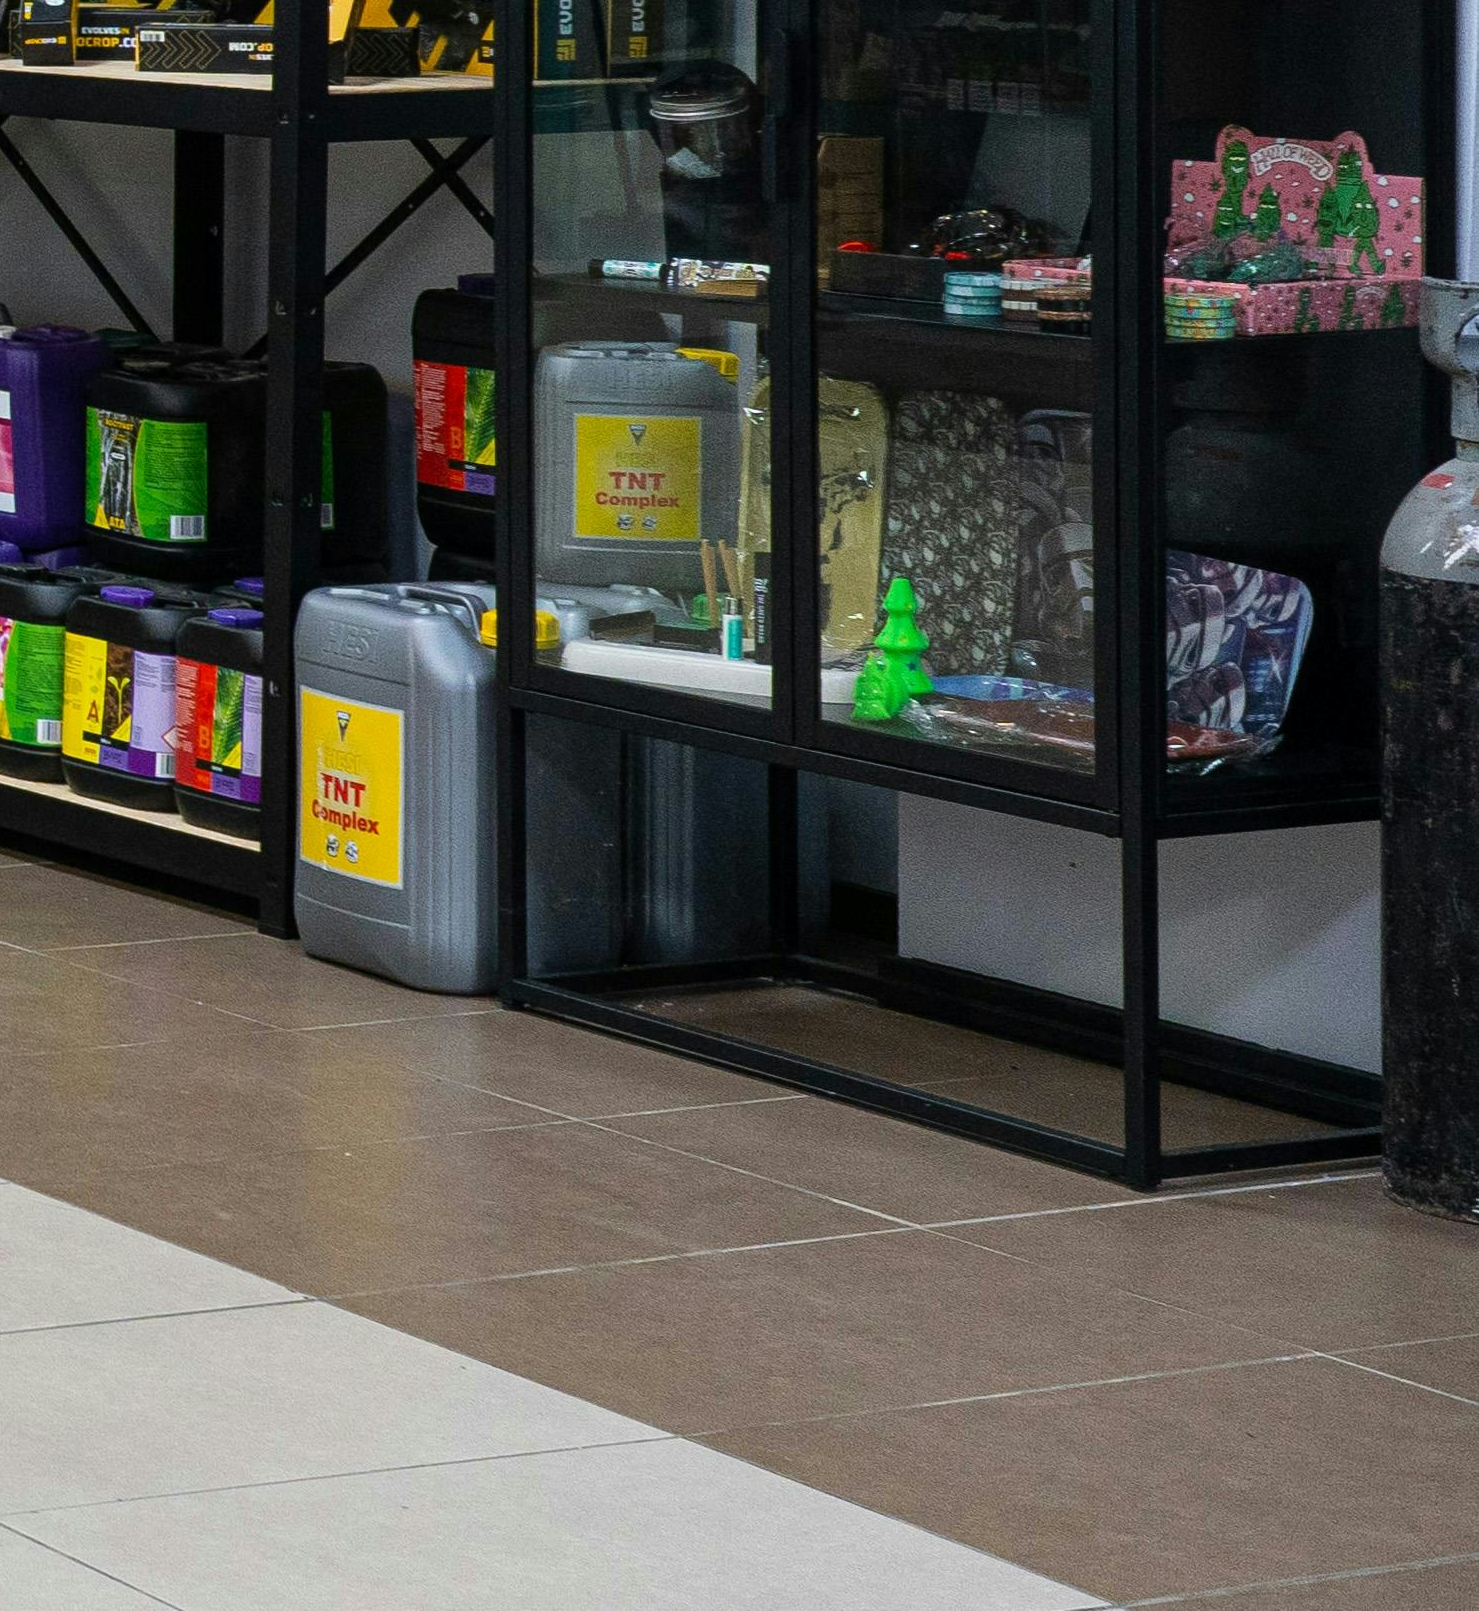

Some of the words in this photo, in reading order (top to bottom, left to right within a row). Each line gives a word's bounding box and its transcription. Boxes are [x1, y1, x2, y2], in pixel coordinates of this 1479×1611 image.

[608, 471, 666, 490] TNT
[595, 491, 681, 509] Complex
[320, 772, 367, 806] TNT
[311, 798, 380, 836] Complex
